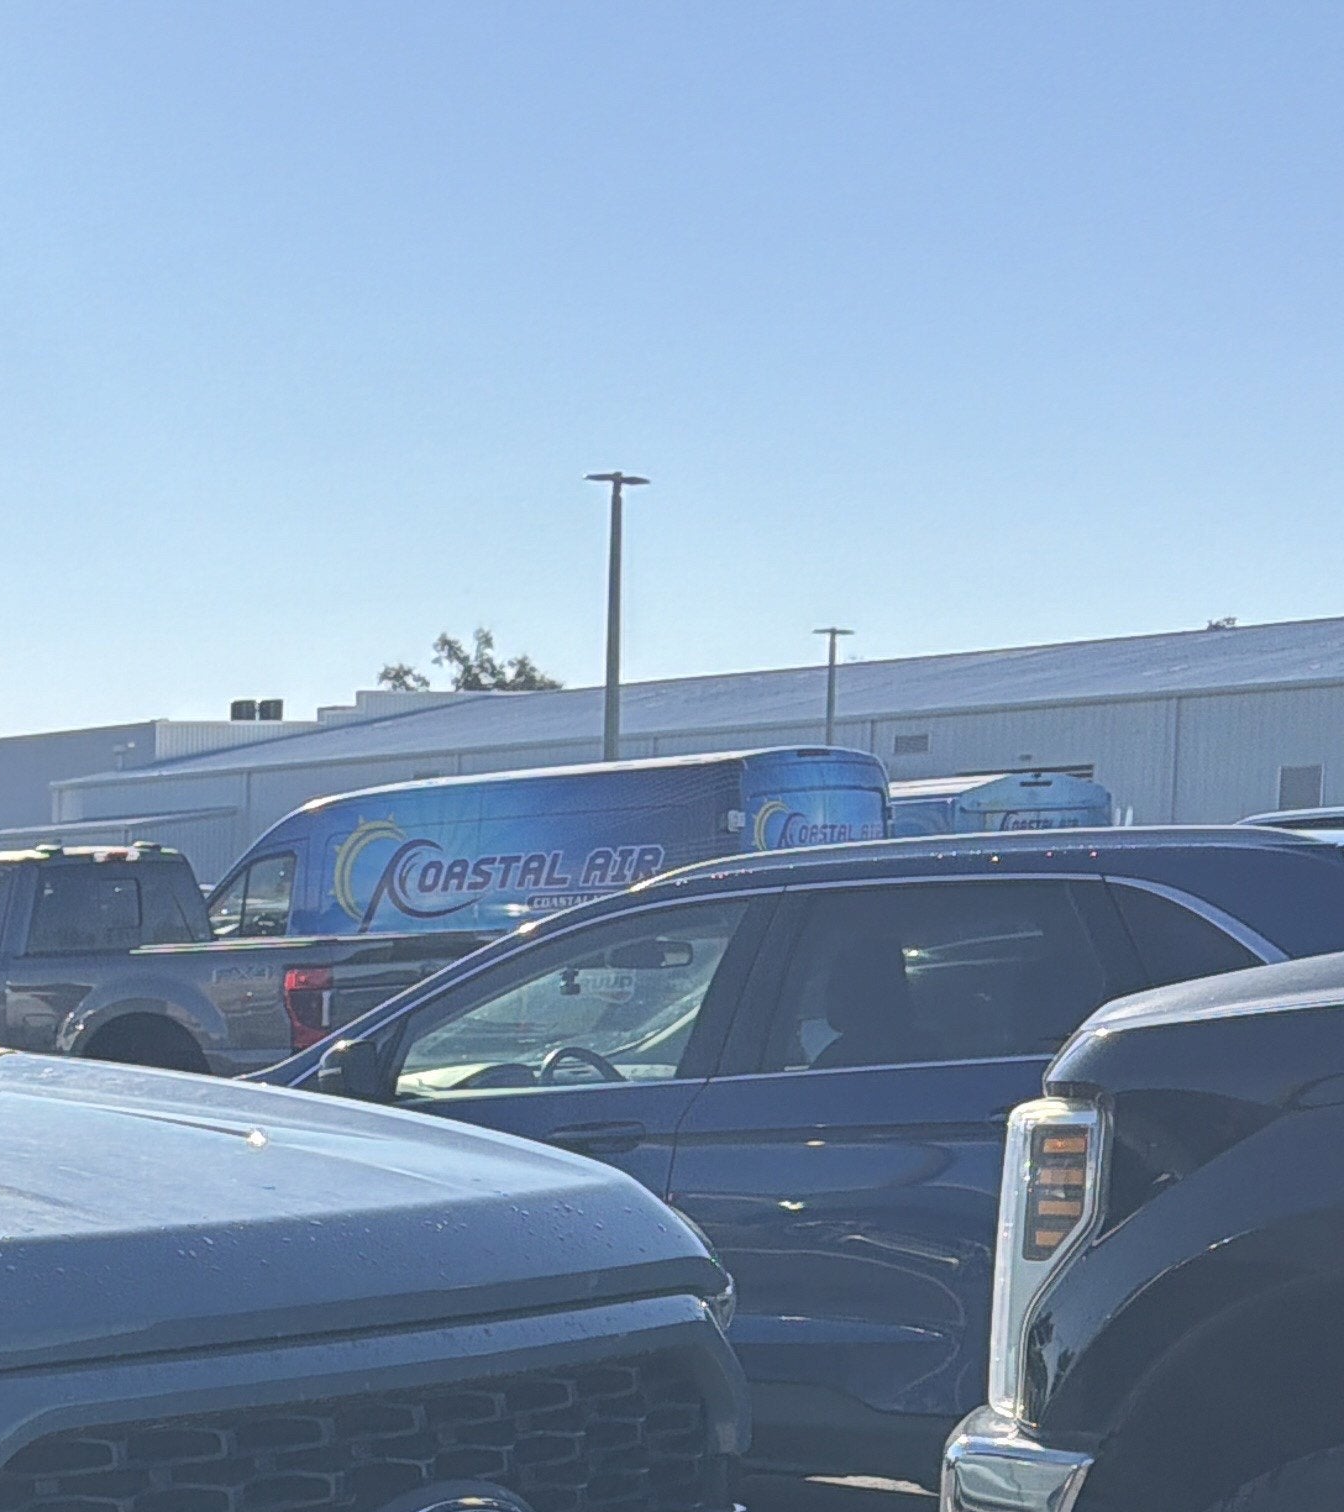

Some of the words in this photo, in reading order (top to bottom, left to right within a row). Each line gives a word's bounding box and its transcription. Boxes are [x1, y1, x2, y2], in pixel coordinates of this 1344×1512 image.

[777, 811, 855, 847] COASTAL
[358, 837, 571, 933] COASTAL
[580, 845, 664, 886] AIR
